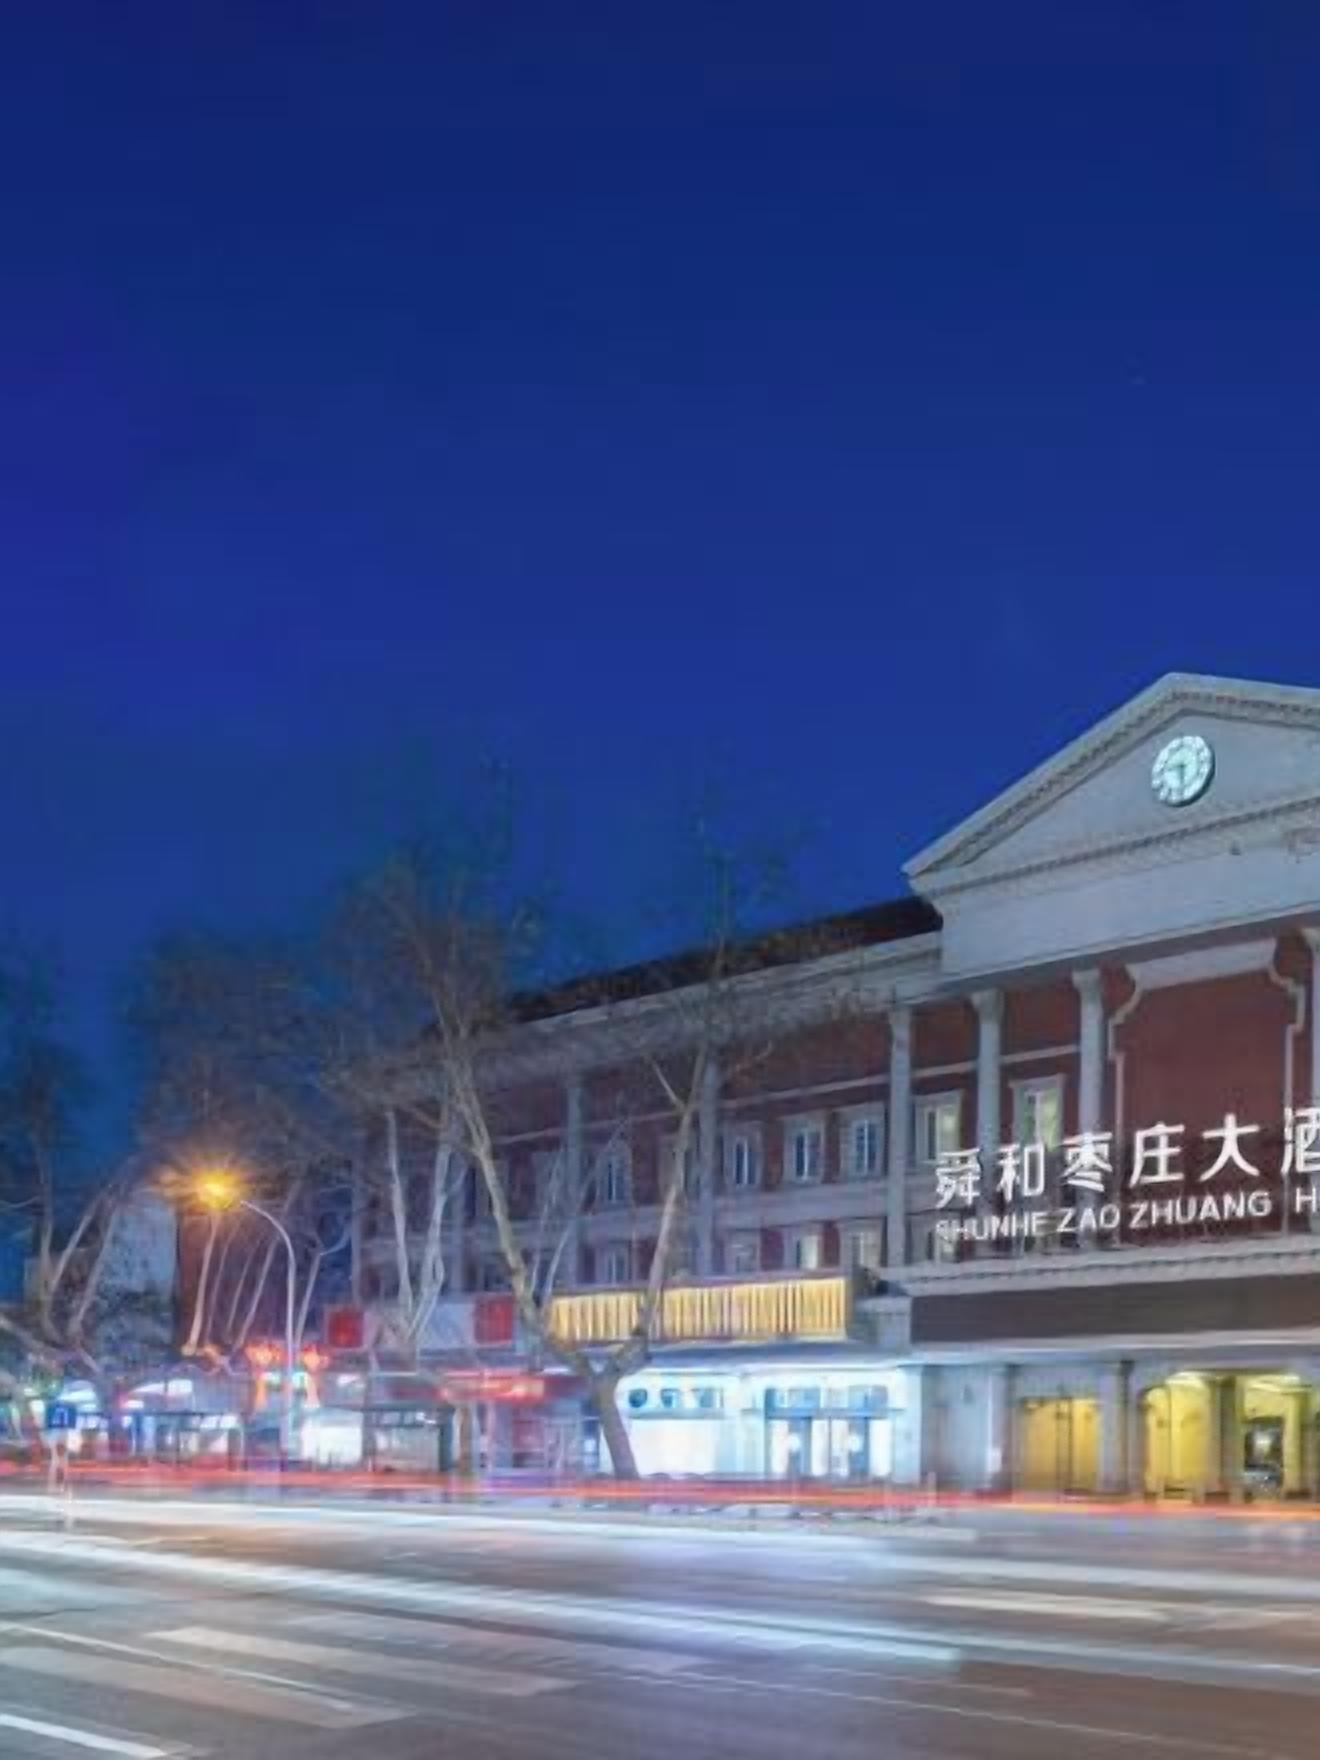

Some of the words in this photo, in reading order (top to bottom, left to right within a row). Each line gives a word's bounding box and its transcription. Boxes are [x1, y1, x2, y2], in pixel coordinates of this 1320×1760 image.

[935, 1211, 1048, 1241] SHUNHE
[1056, 1205, 1121, 1234] ZAO
[1128, 1191, 1273, 1231] ZHUANG
